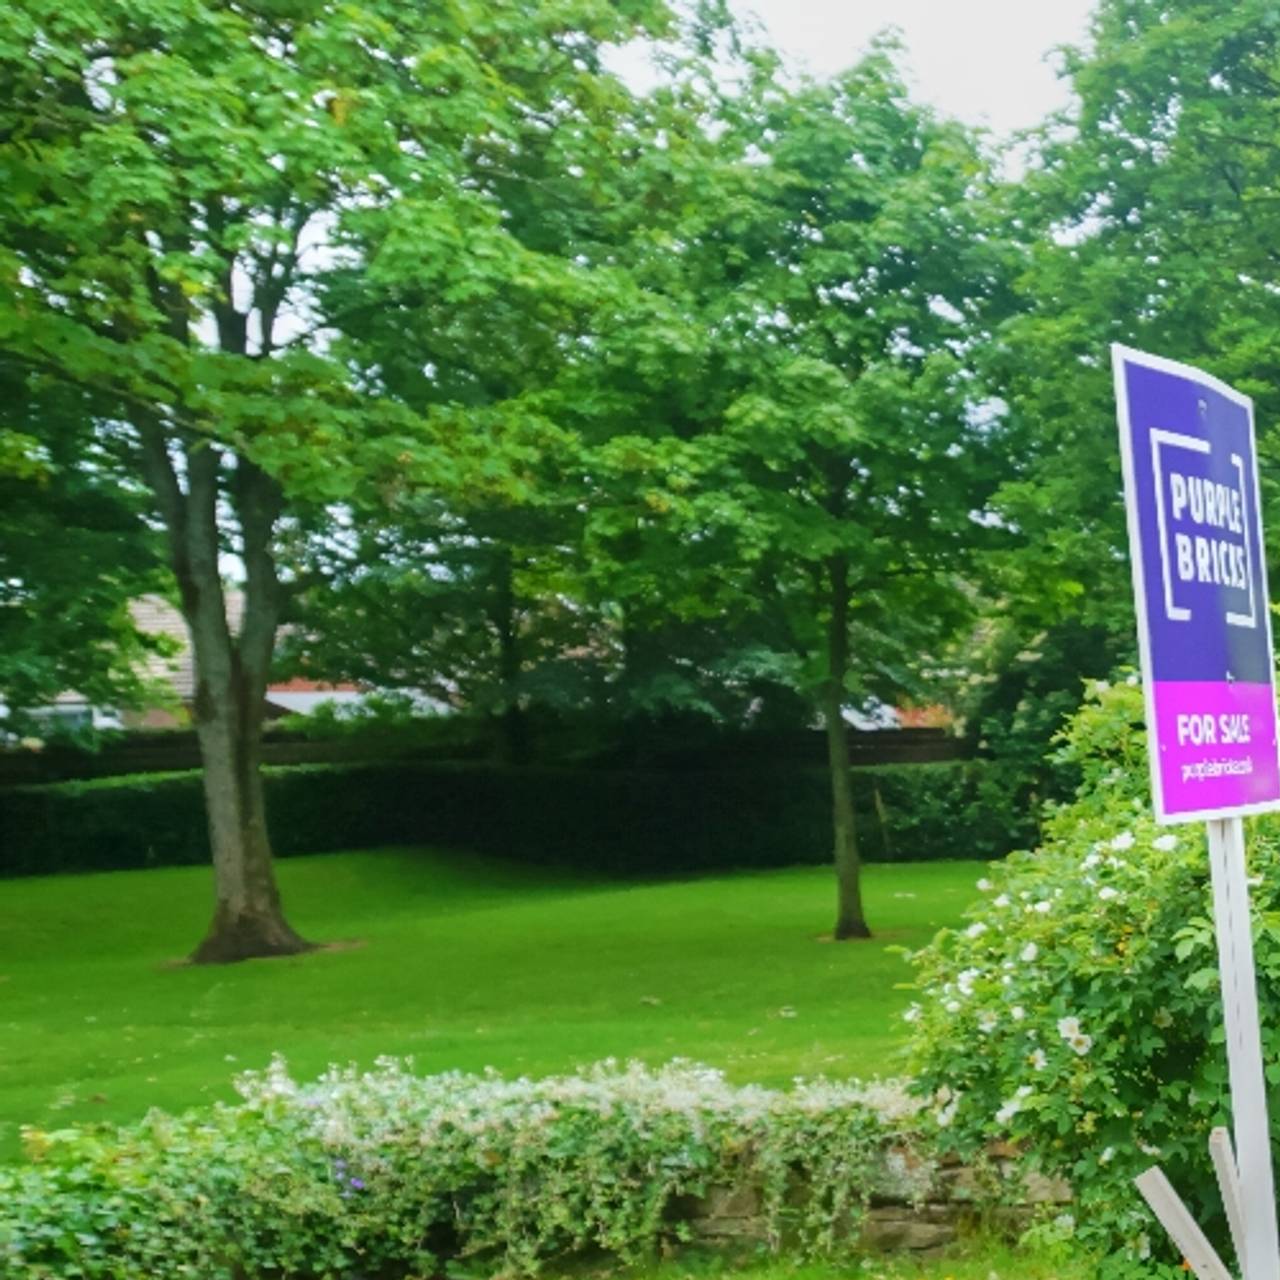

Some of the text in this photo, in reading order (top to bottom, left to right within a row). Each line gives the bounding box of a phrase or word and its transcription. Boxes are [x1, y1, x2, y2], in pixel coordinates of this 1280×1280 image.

[1170, 472, 1242, 534] PURPLE
[1175, 532, 1246, 590] BRICKS
[1177, 713, 1217, 747] FOR
